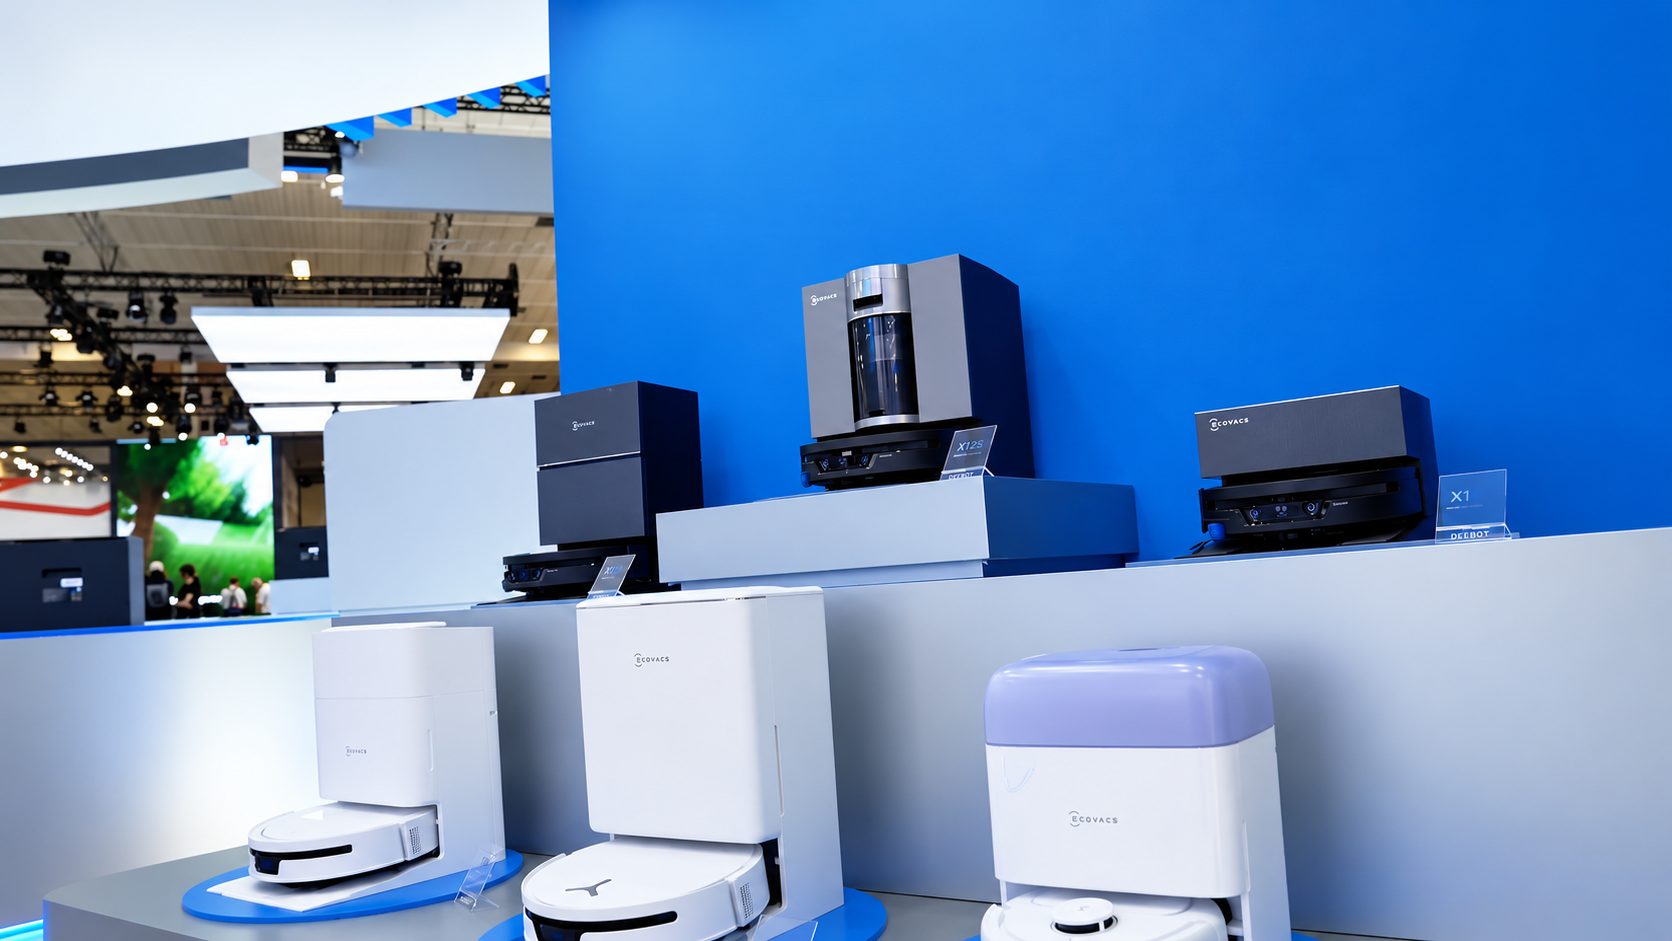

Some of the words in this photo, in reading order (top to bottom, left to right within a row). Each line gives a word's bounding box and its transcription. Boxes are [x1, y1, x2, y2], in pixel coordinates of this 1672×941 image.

[1209, 417, 1249, 431] ECOVACS
[956, 439, 984, 452] X12S
[1450, 490, 1470, 503] X1
[633, 652, 670, 668] ECOVACS
[1068, 810, 1118, 828] ECOVACS
